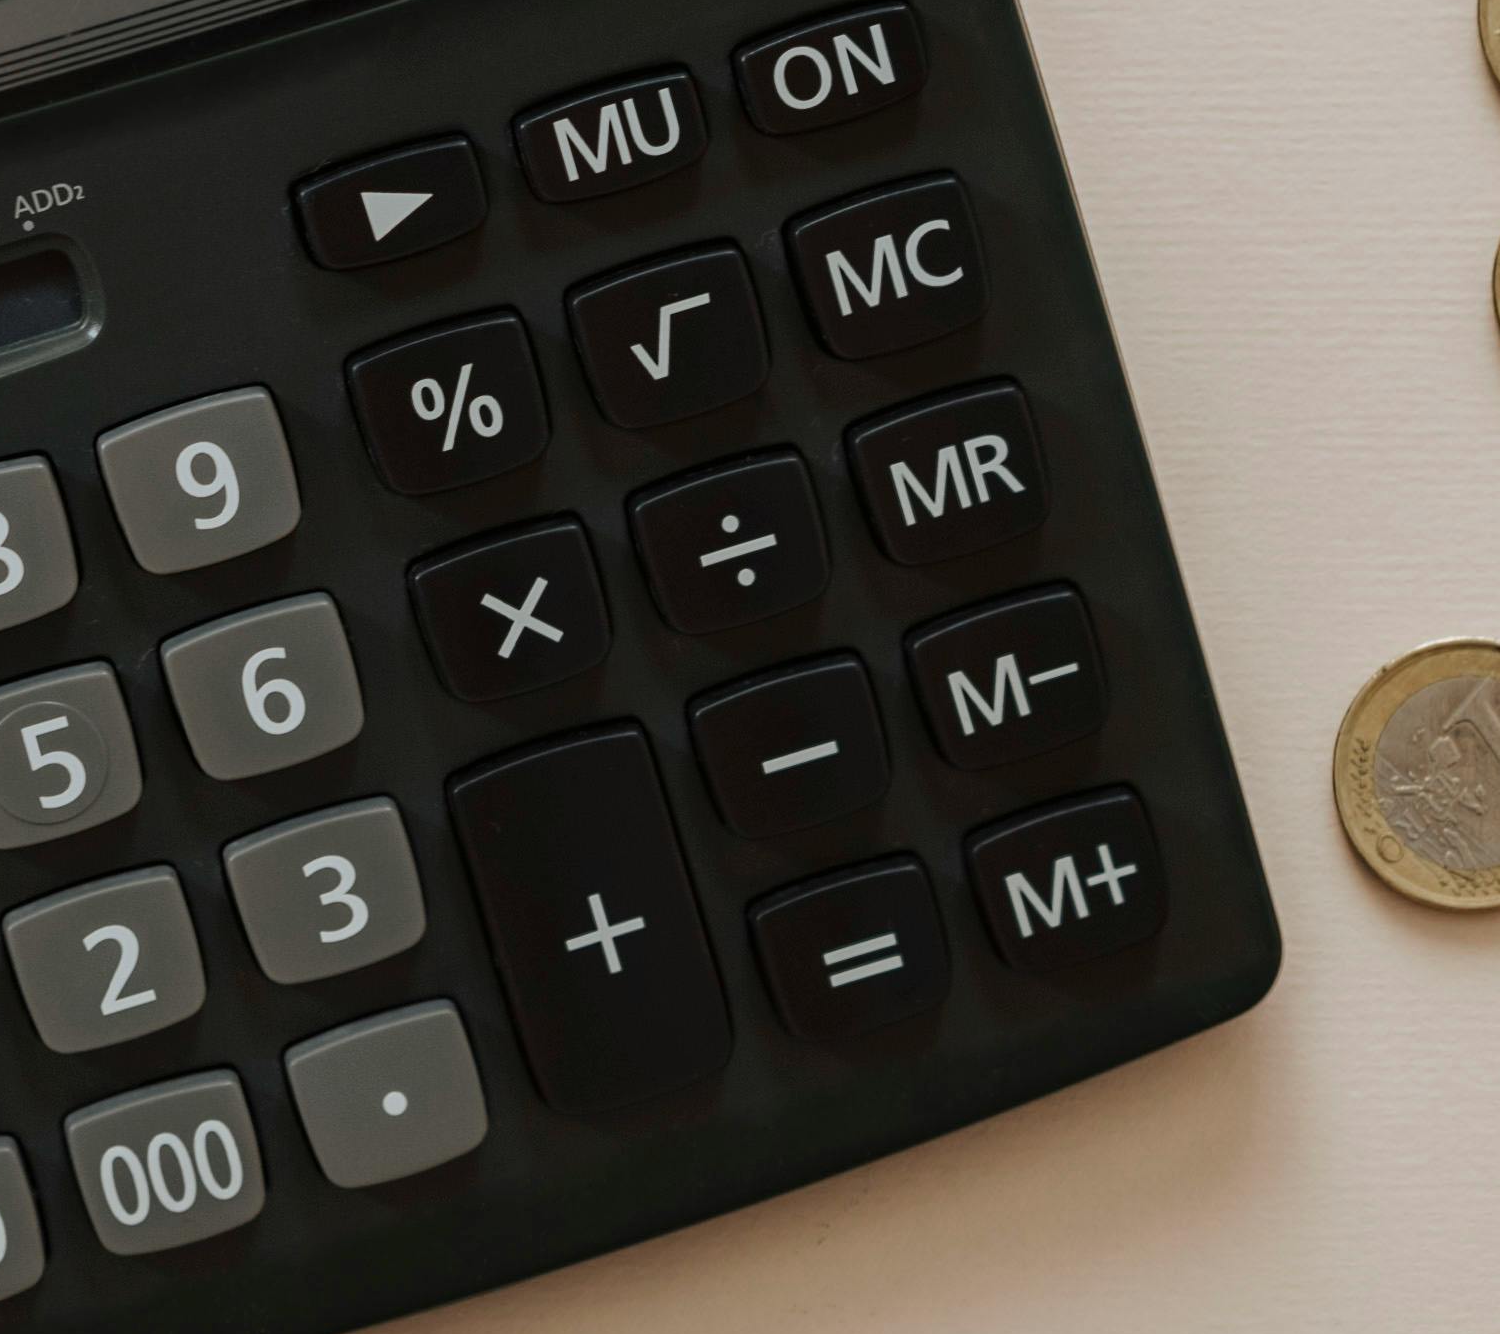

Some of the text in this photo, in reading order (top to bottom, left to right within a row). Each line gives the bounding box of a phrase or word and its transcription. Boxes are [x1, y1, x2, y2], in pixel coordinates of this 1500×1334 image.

[773, 23, 896, 110] ON
[552, 87, 680, 182] MU
[825, 219, 964, 317] MC
[175, 441, 240, 530] 9
[889, 434, 1026, 527] MR
[241, 646, 306, 735] 6
[20, 715, 87, 809] 5
[302, 854, 369, 943] 3
[1004, 844, 1137, 938] M+
[82, 924, 157, 1016] 2
[100, 1119, 243, 1226] 000
